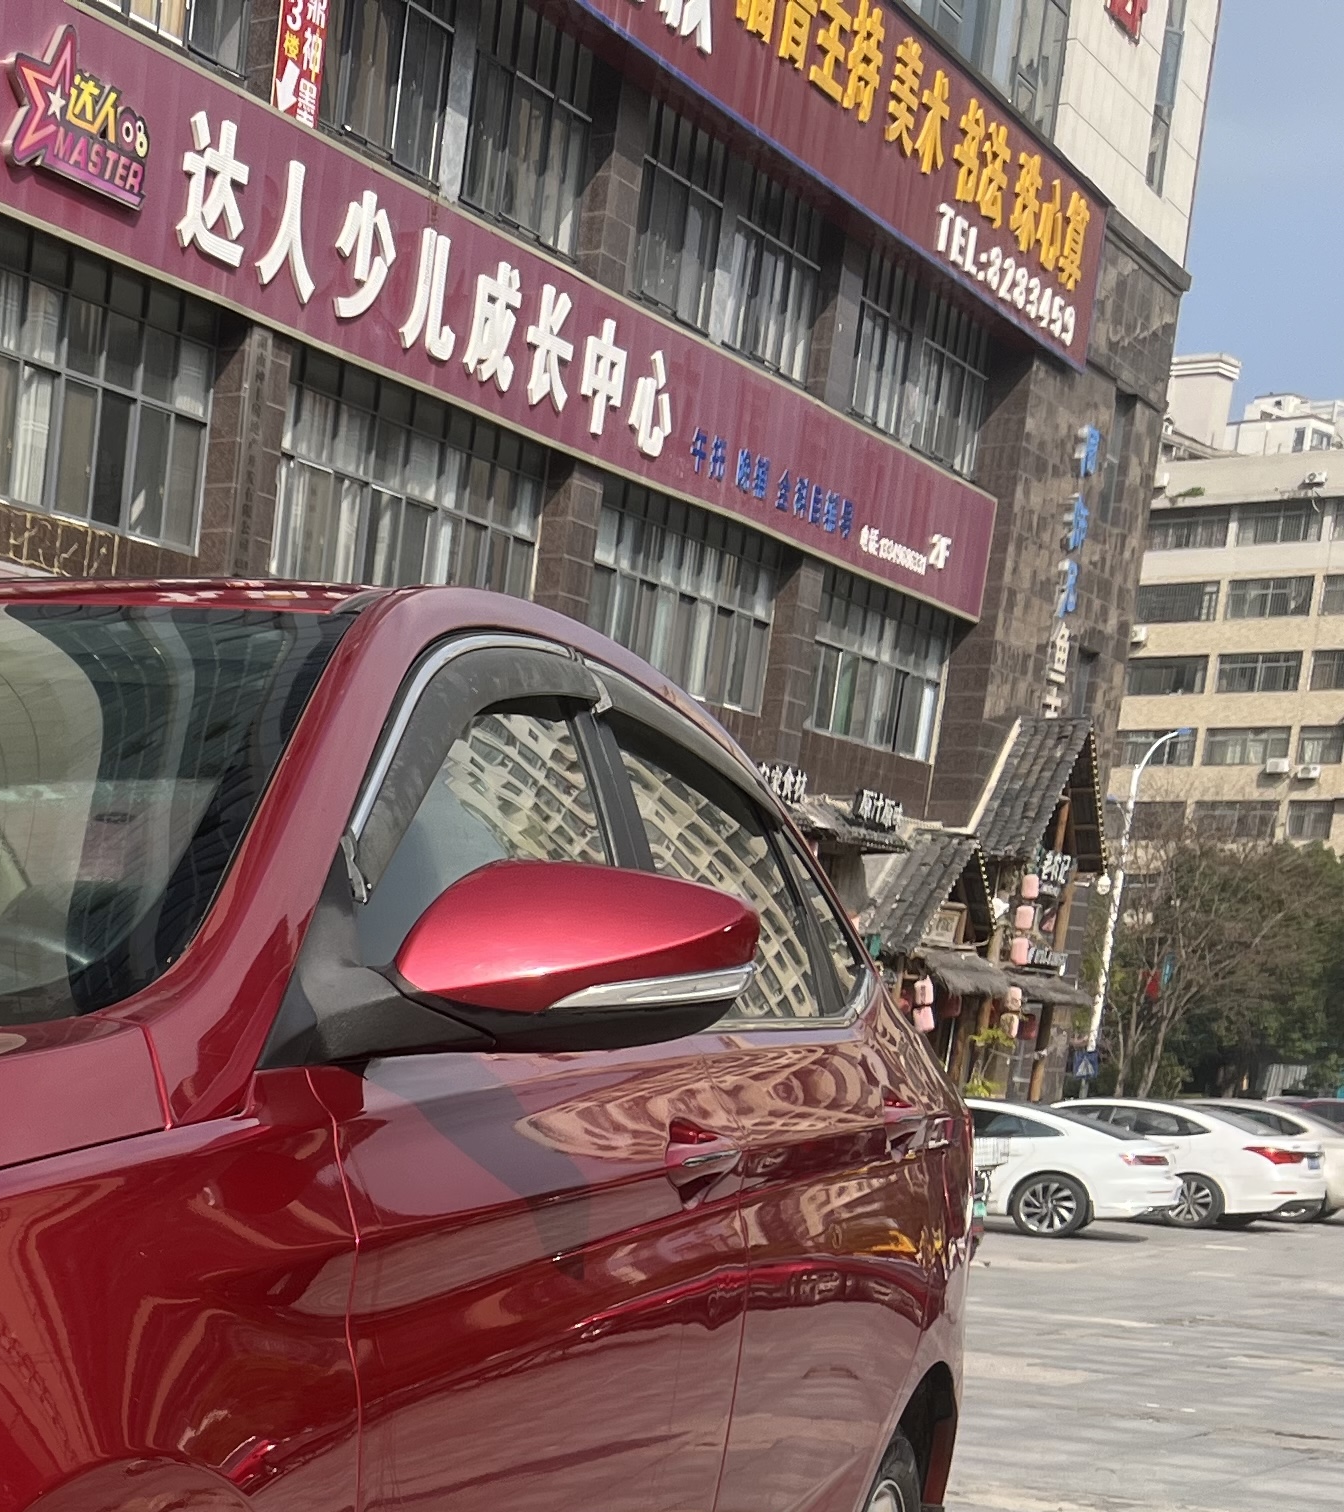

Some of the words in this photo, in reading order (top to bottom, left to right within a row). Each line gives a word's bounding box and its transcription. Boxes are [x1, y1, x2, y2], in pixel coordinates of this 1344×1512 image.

[54, 126, 144, 194] MASTER
[176, 110, 673, 459] 达人少儿成长中心
[885, 37, 950, 175] 美术
[1010, 152, 1091, 292] 珠心算
